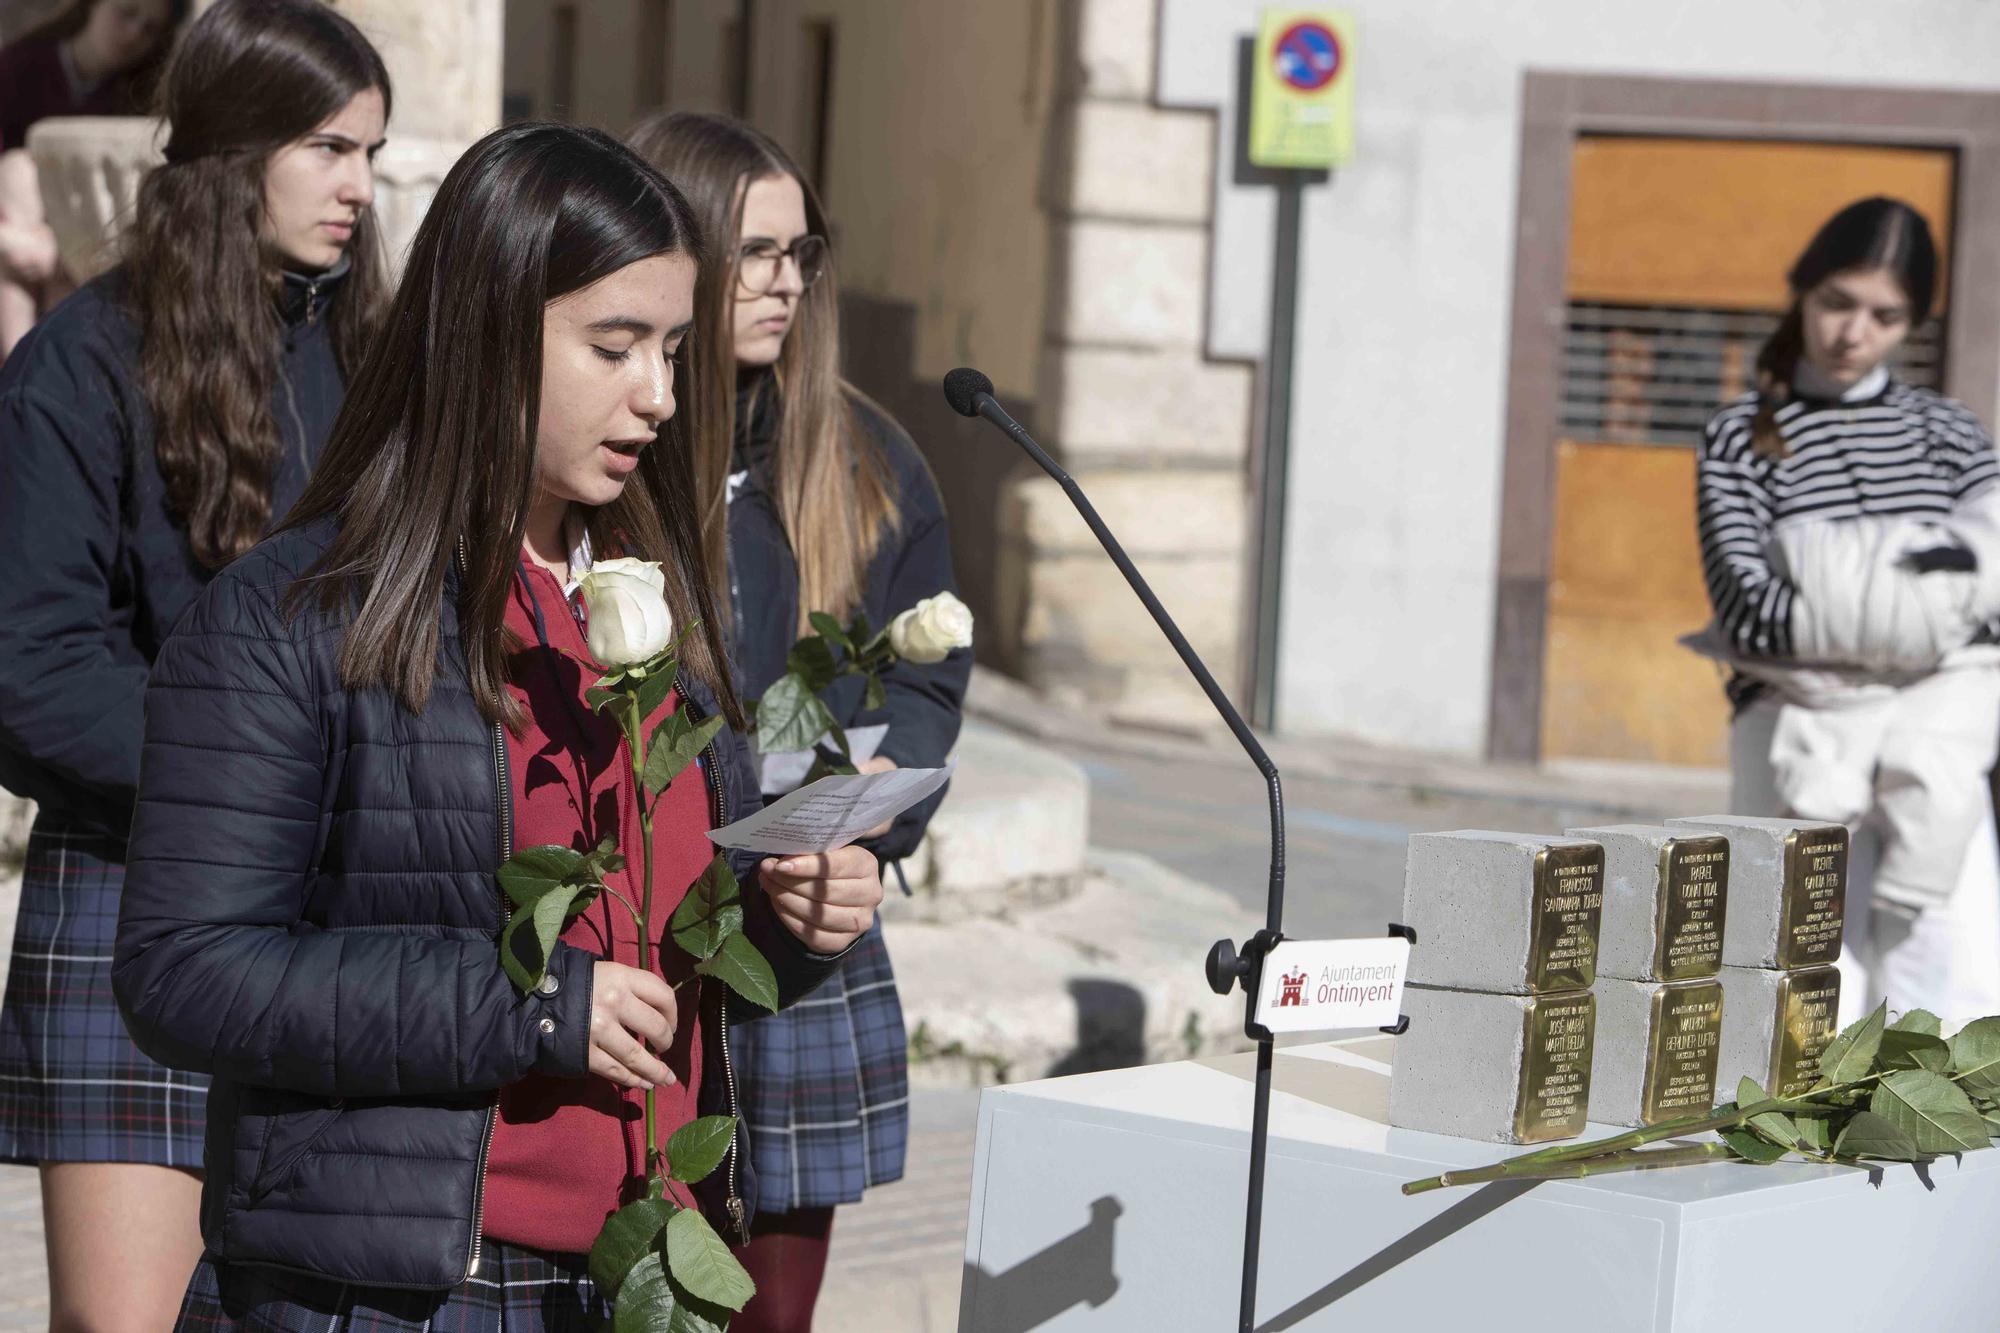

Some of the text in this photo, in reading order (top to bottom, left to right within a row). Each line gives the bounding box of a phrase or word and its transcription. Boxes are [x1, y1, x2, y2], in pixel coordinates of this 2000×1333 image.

[1812, 856, 1835, 871] VICENTE
[1690, 865, 1712, 881] RAFAEL
[1560, 877, 1593, 894] FRANCISCO
[1682, 881, 1718, 898] DONAT VIDAL
[1319, 964, 1397, 985] Ajuntament
[1317, 982, 1395, 1007] Ontinyent
[1548, 1015, 1585, 1035] JOSÉ MARÍA
[1545, 1033, 1585, 1053] MARTÍ BELDA
[1666, 1034, 1696, 1051] BERLINER
